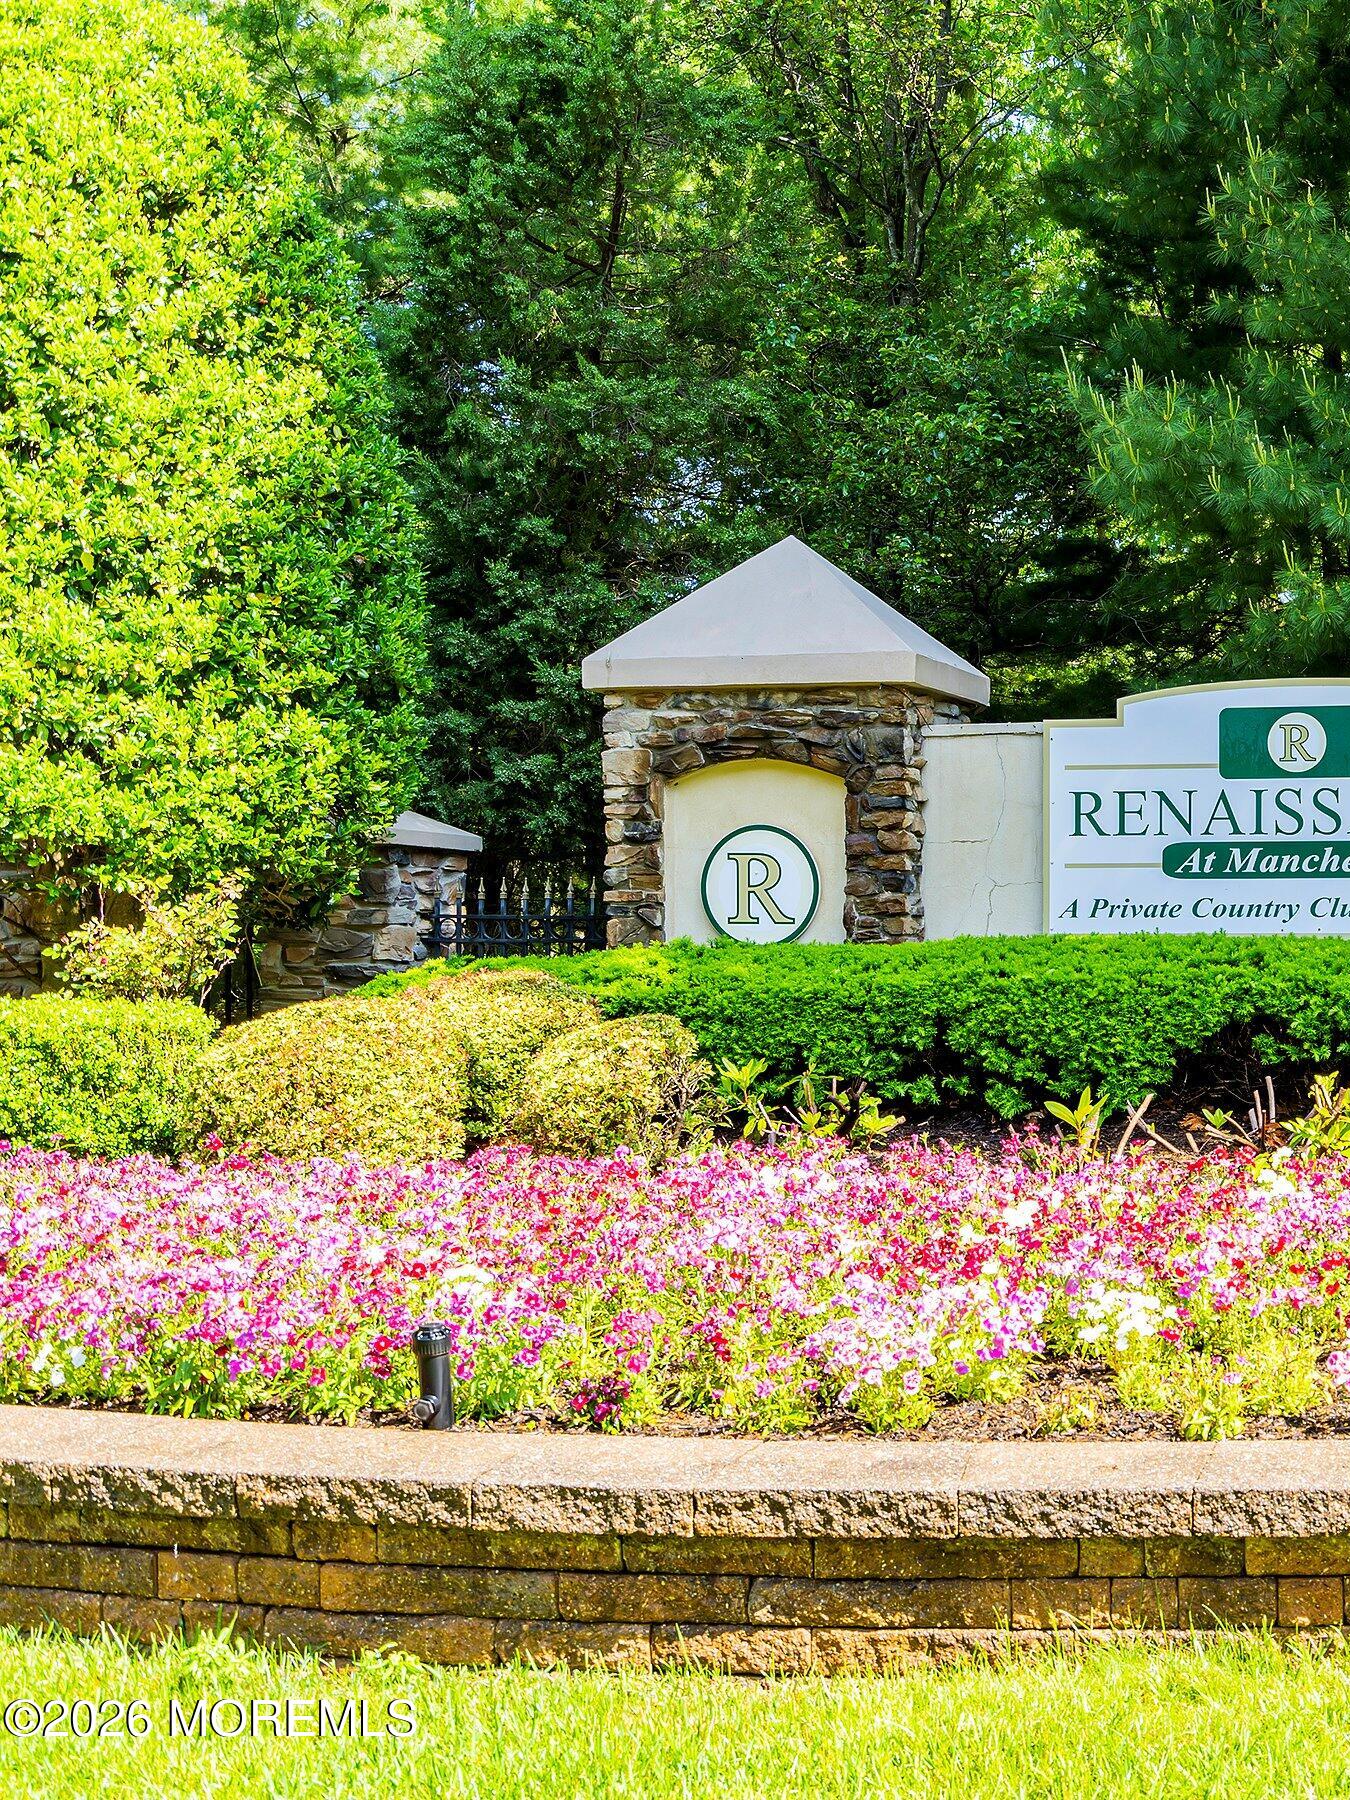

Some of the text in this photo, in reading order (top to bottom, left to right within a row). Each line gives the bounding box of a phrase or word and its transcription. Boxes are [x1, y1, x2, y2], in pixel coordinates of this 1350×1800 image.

[1279, 724, 1317, 762] R
[1175, 849, 1218, 873] At
[727, 853, 795, 924] R
[1058, 898, 1079, 919] A
[1088, 898, 1182, 919] Private
[1191, 898, 1300, 923] Country
